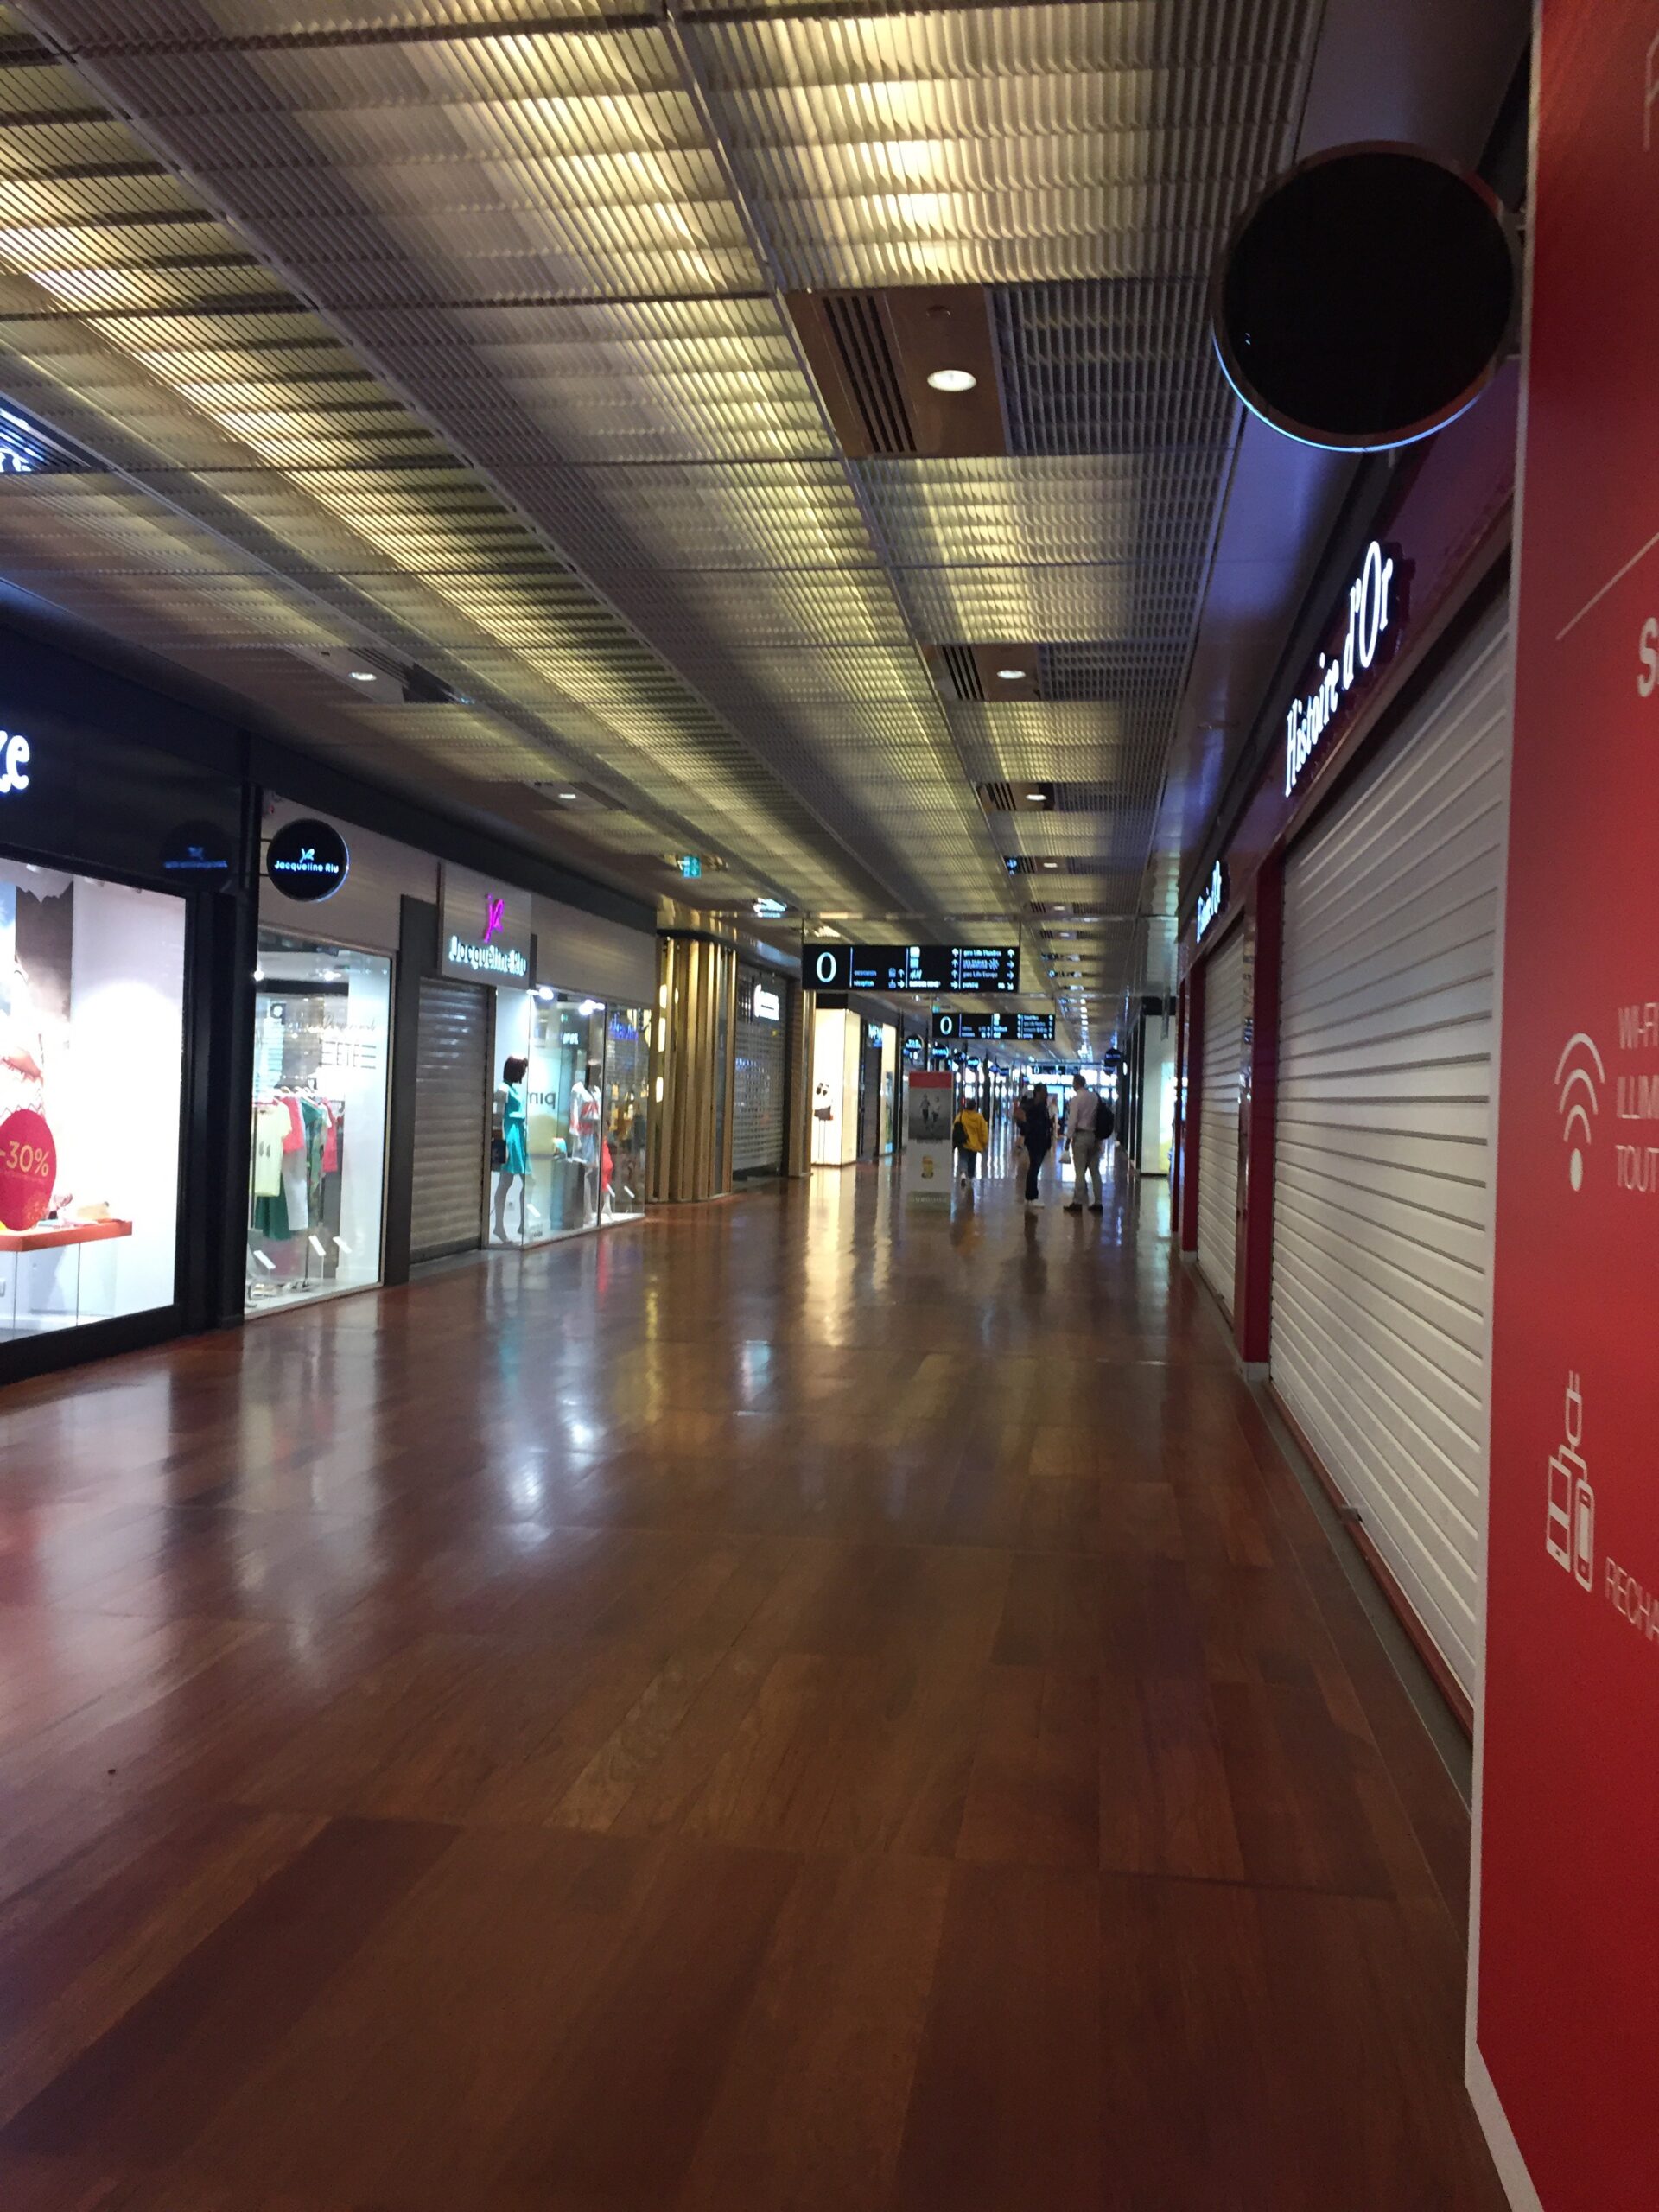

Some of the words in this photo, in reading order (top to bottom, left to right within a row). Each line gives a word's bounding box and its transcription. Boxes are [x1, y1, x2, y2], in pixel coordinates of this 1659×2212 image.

[274, 860, 323, 872] Jacqueline
[325, 862, 339, 874] Riu
[816, 951, 836, 983] 0
